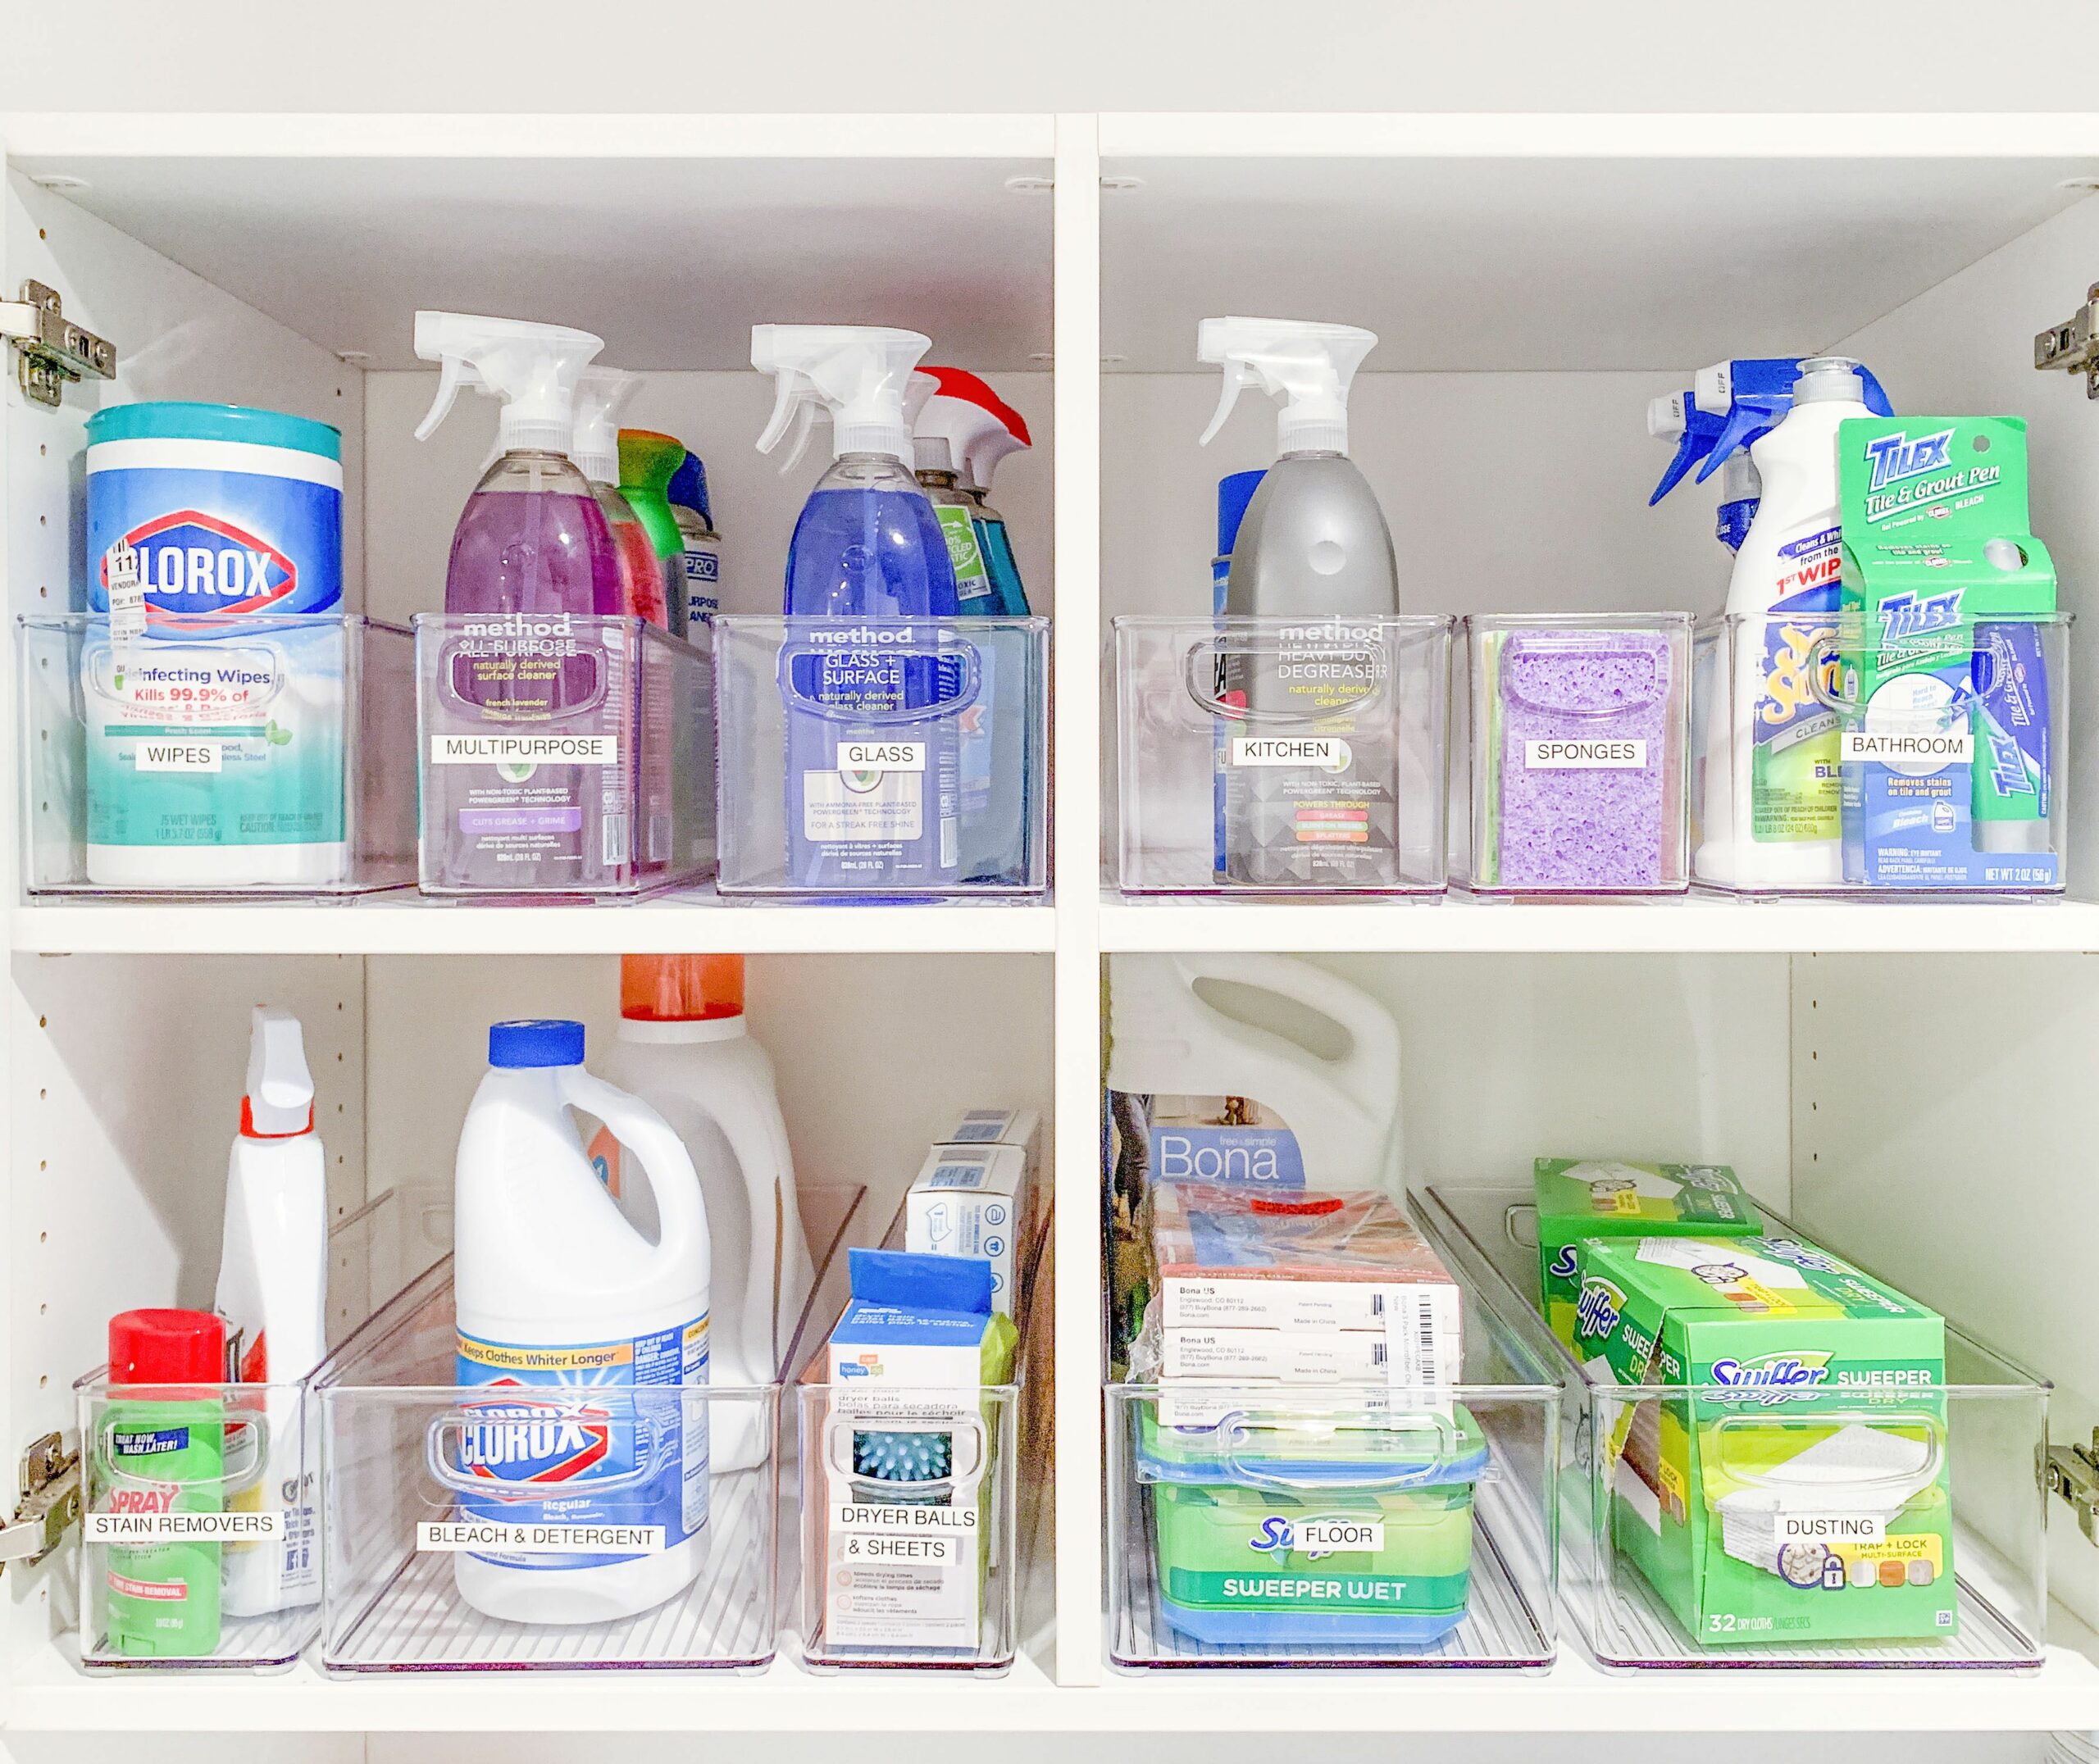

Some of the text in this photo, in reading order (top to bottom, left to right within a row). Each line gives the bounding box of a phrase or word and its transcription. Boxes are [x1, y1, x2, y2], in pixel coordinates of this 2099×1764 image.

[1864, 428, 1956, 493] TILEX
[1866, 466, 2001, 516] Tile & Grout Pen
[1955, 495, 1984, 510] BLEACH
[1795, 535, 1824, 553] Cleans &
[1801, 547, 1839, 566] from the
[128, 546, 271, 598] LOROX
[1878, 587, 1967, 642] TILEX
[463, 612, 574, 637] method
[1279, 615, 1384, 641] method
[809, 625, 913, 643] method
[473, 659, 561, 671] naturally derived
[826, 653, 896, 668] GLASS +
[1877, 652, 1896, 666] Tile
[217, 669, 271, 685] Wipes
[477, 671, 557, 680] surface cleaner
[822, 670, 900, 685] SURFACE
[135, 688, 249, 702] Kills 99.9% of
[818, 690, 904, 703] naturally derived
[1289, 684, 1335, 694] naturally
[857, 702, 895, 711] cleaner
[446, 740, 603, 755] MULTIPURPOSE
[1245, 742, 1329, 757] KITCHEN
[1537, 743, 1636, 760] SPONGES
[1853, 737, 1964, 755] BATHROOM
[148, 747, 210, 763] WIPES
[849, 747, 913, 762] GLASS
[1987, 734, 2036, 798] TILEX
[1887, 777, 1951, 787] Removes stains
[1887, 788, 1952, 798] on tile and grout
[1331, 801, 1370, 809] THROUGH
[171, 814, 217, 825] WET WIPES
[473, 816, 566, 826] CUTS GREASE GRIME
[812, 821, 826, 830] FOR
[836, 821, 866, 829] STREAK
[890, 820, 915, 828] SHINE
[1985, 867, 2000, 882] NET
[2001, 867, 2013, 881] WT
[2015, 867, 2020, 881] 2
[2020, 867, 2031, 881] OZ
[1219, 1136, 1277, 1148] free simple
[1160, 1135, 1280, 1180] Bona
[464, 1344, 617, 1366] Keeps Clothes Whiter Longer
[841, 1366, 866, 1375] honey
[1837, 1370, 1932, 1385] SWEEPER
[123, 1440, 178, 1454] WASH LATER!
[110, 1485, 180, 1513] SPRAY
[543, 1499, 591, 1512] Regular
[842, 1507, 975, 1527] DRYER BALLS
[96, 1517, 273, 1533] STAIN REMOVERS
[1787, 1520, 1874, 1535] DUSTING
[429, 1528, 655, 1545] BLEACH & DETERGENT
[1306, 1527, 1374, 1543] FLOOR
[849, 1539, 945, 1557] & SHEETS
[1853, 1539, 1927, 1550] TRAP + LOCK
[499, 1552, 526, 1562] Formula
[1861, 1550, 1923, 1559] MULTI-SURFACE
[144, 1586, 182, 1596] REMOVAL
[1223, 1579, 1407, 1600] SWEEPER WET
[1709, 1613, 1751, 1632] 32 DRY
